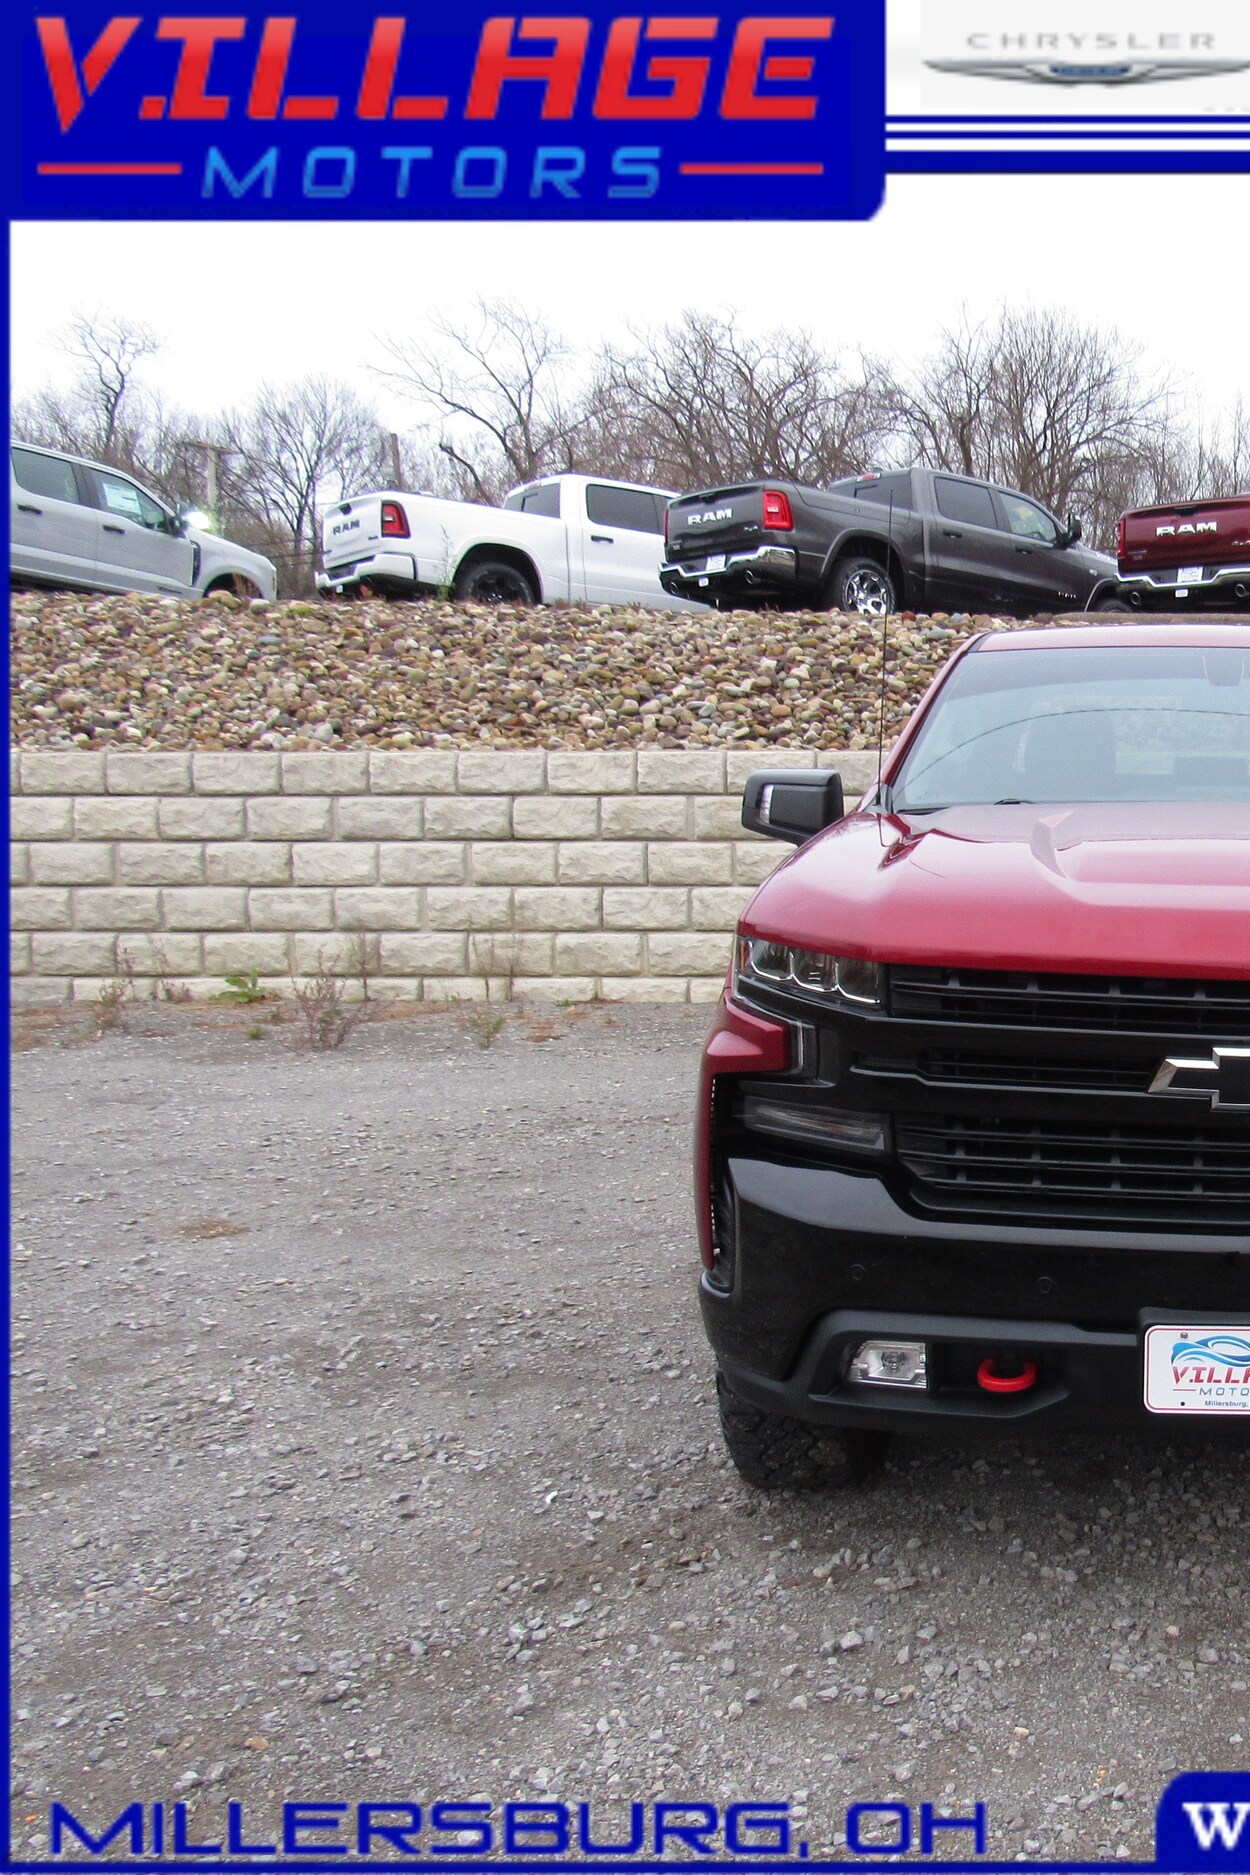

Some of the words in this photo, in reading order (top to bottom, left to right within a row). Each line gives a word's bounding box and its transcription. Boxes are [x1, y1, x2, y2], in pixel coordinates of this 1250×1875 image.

[687, 508, 733, 525] RAM
[332, 519, 360, 535] RAM
[1156, 521, 1217, 536] RAM
[1204, 1400, 1249, 1408] Millersburg,
